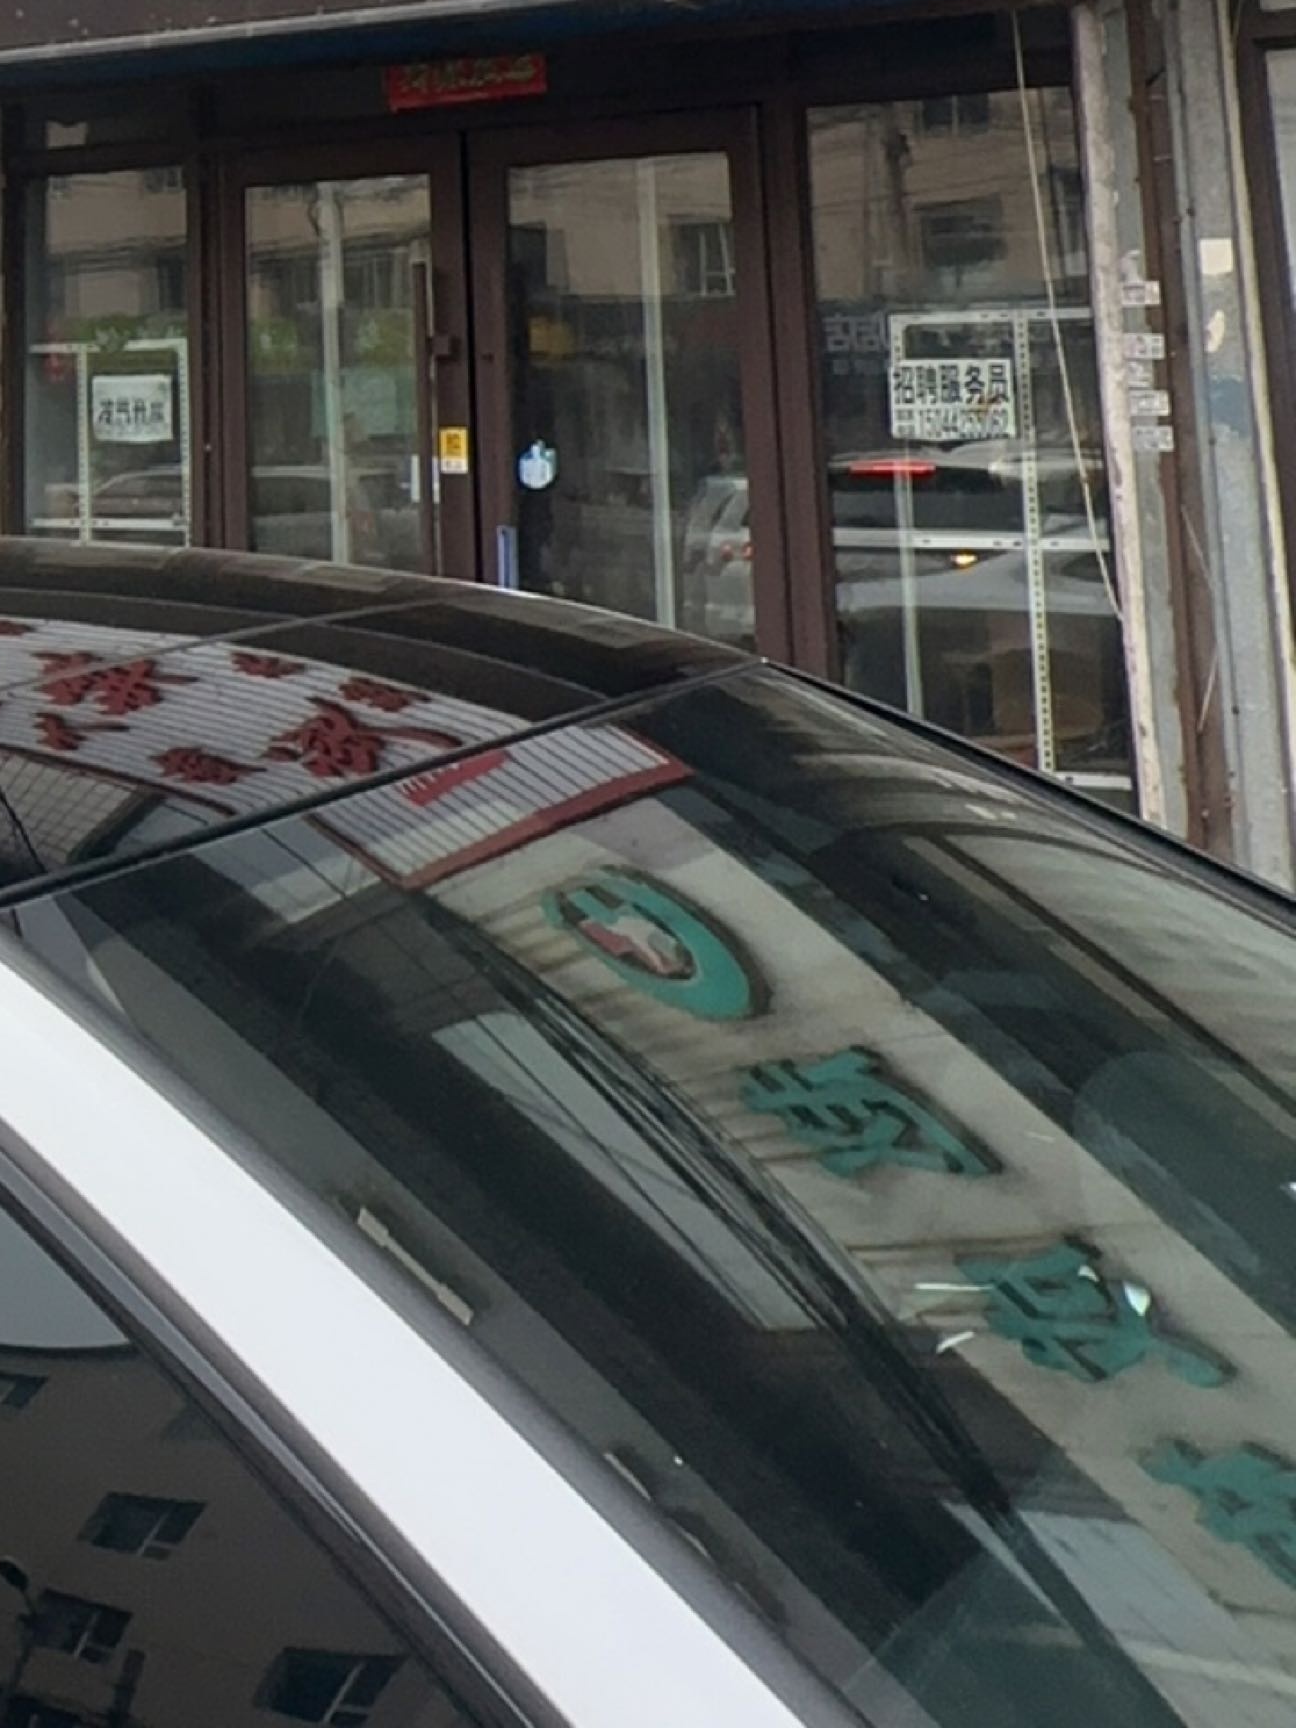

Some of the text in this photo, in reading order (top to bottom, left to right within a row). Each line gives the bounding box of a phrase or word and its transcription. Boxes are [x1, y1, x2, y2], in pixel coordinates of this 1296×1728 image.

[893, 363, 1010, 405] 招聘服务员
